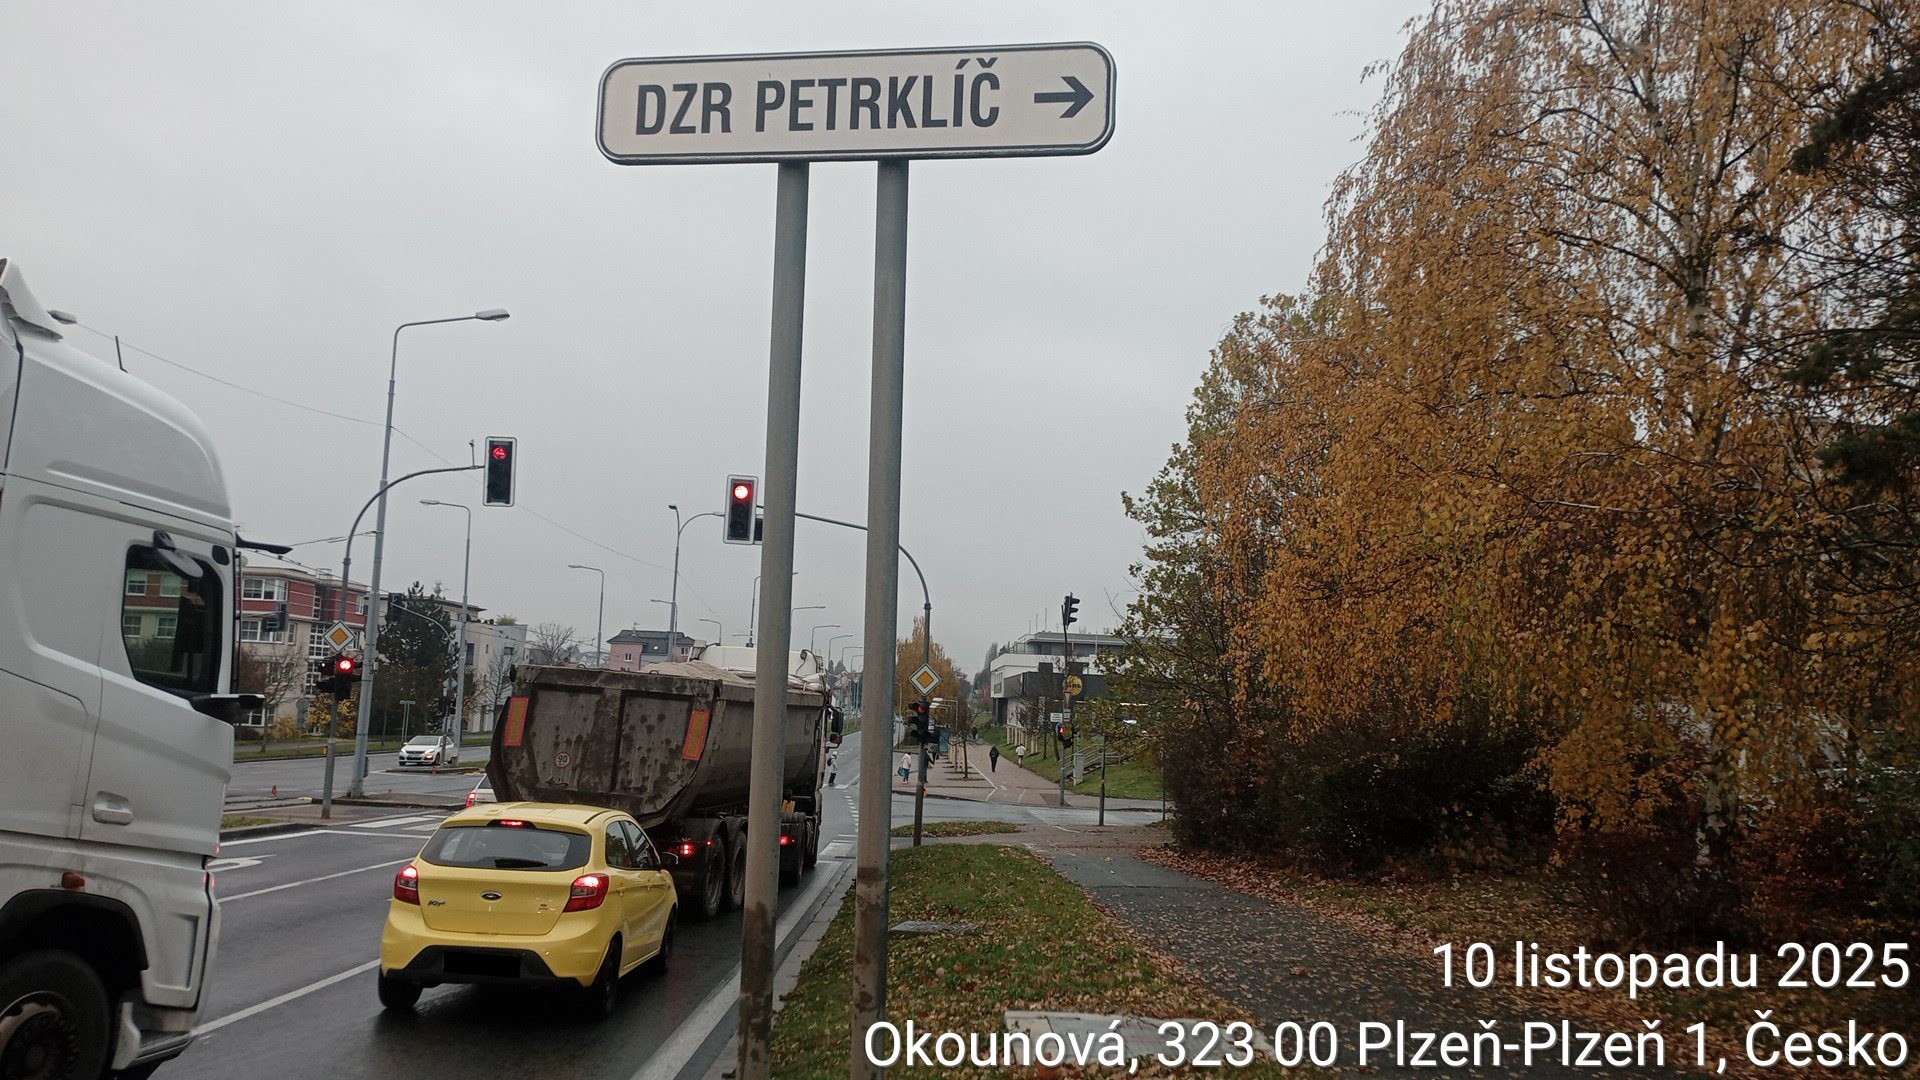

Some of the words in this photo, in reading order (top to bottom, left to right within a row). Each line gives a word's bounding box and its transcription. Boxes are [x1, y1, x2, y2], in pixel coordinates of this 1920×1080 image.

[636, 83, 733, 135] DZR
[755, 57, 1000, 134] PETRKLÍČ
[557, 754, 568, 763] 90
